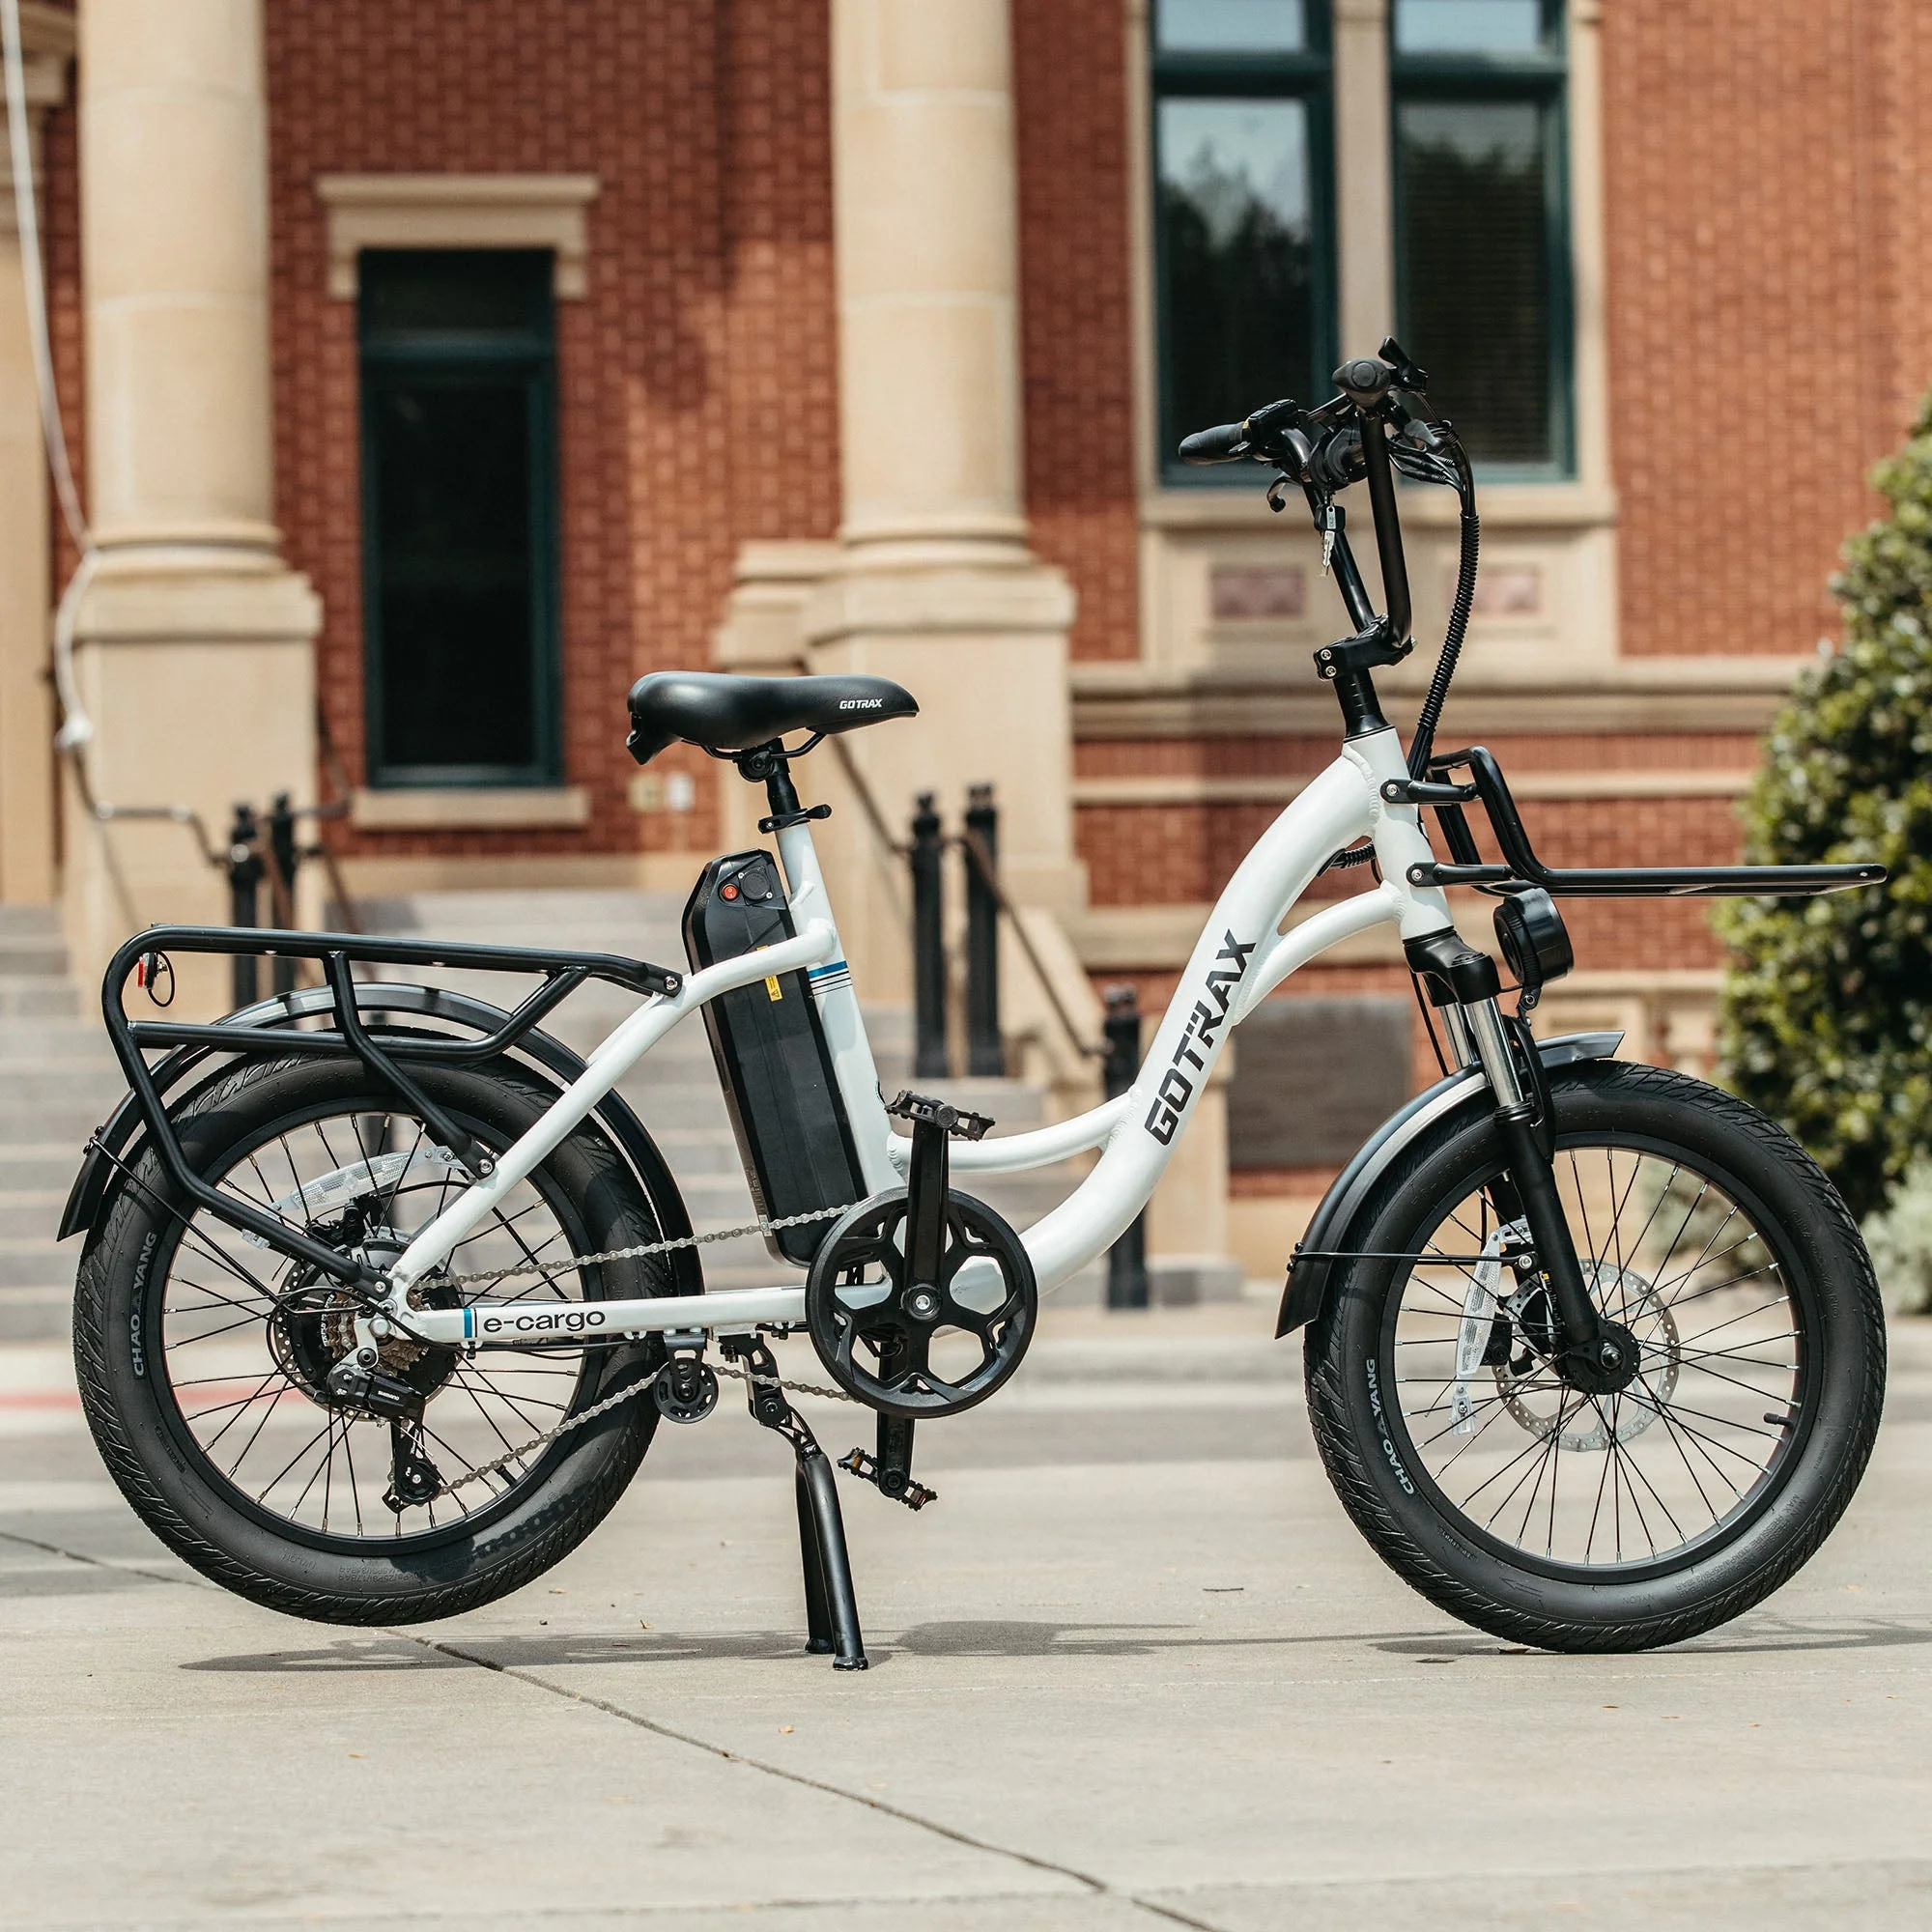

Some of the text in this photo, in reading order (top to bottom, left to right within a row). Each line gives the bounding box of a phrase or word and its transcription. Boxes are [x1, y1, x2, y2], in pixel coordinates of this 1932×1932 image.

[839, 697, 883, 710] GOTRAX
[1145, 928, 1256, 1146] GOTRAX
[130, 1232, 157, 1377] CHAO YANG
[483, 1310, 606, 1333] e-cargo
[1366, 1358, 1414, 1494] CHAO YANG
